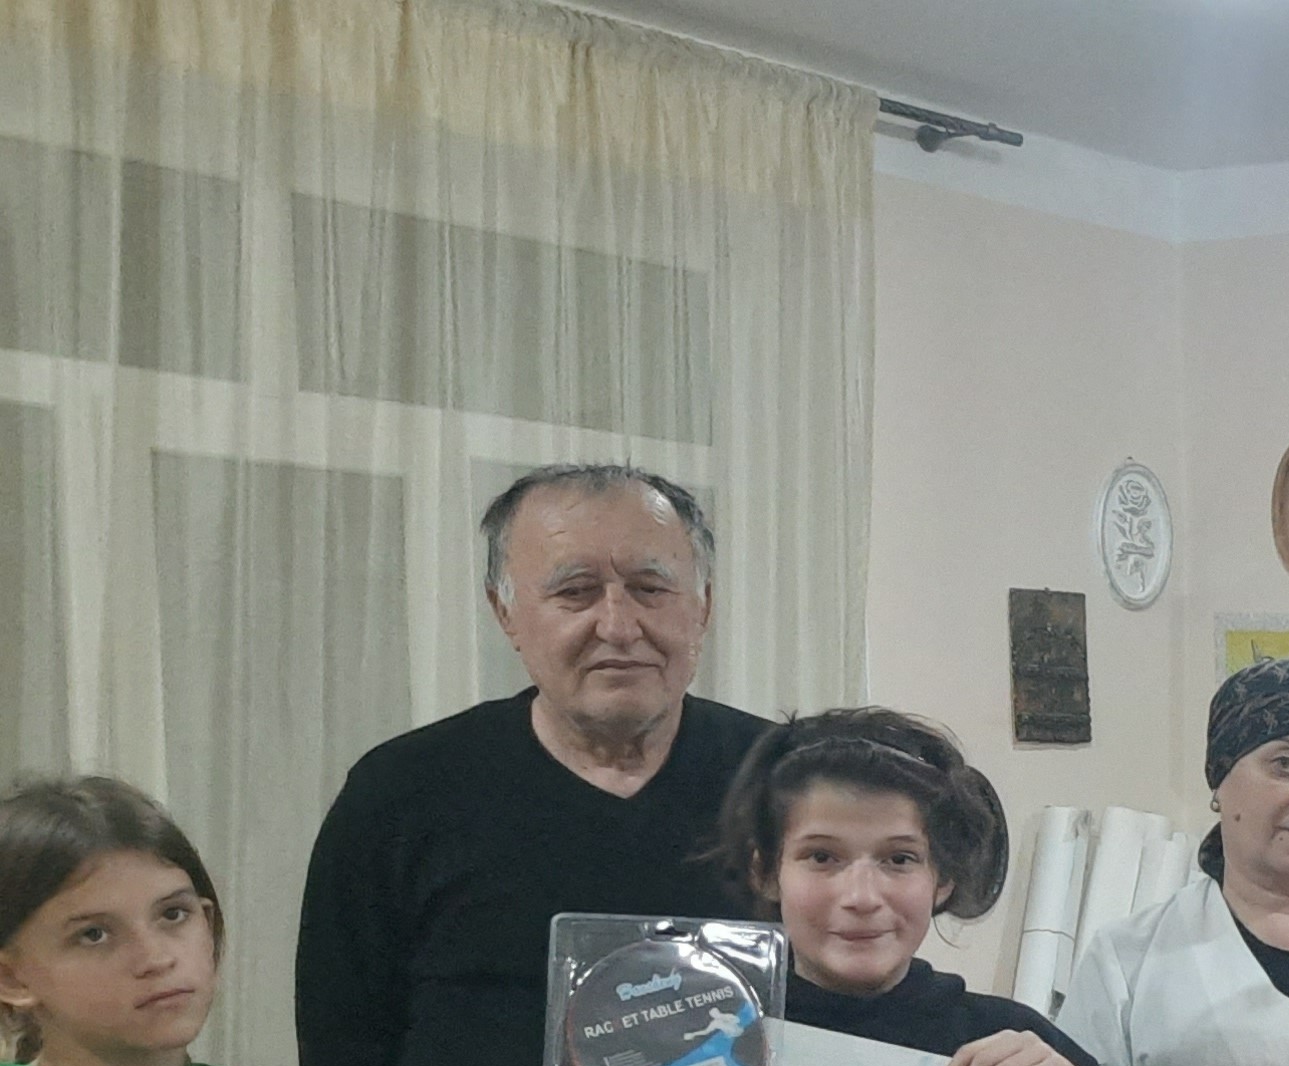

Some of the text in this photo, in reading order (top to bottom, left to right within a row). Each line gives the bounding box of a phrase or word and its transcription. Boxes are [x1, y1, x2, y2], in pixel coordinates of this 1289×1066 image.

[584, 986, 735, 1038] RACET TABLE TENNIS
